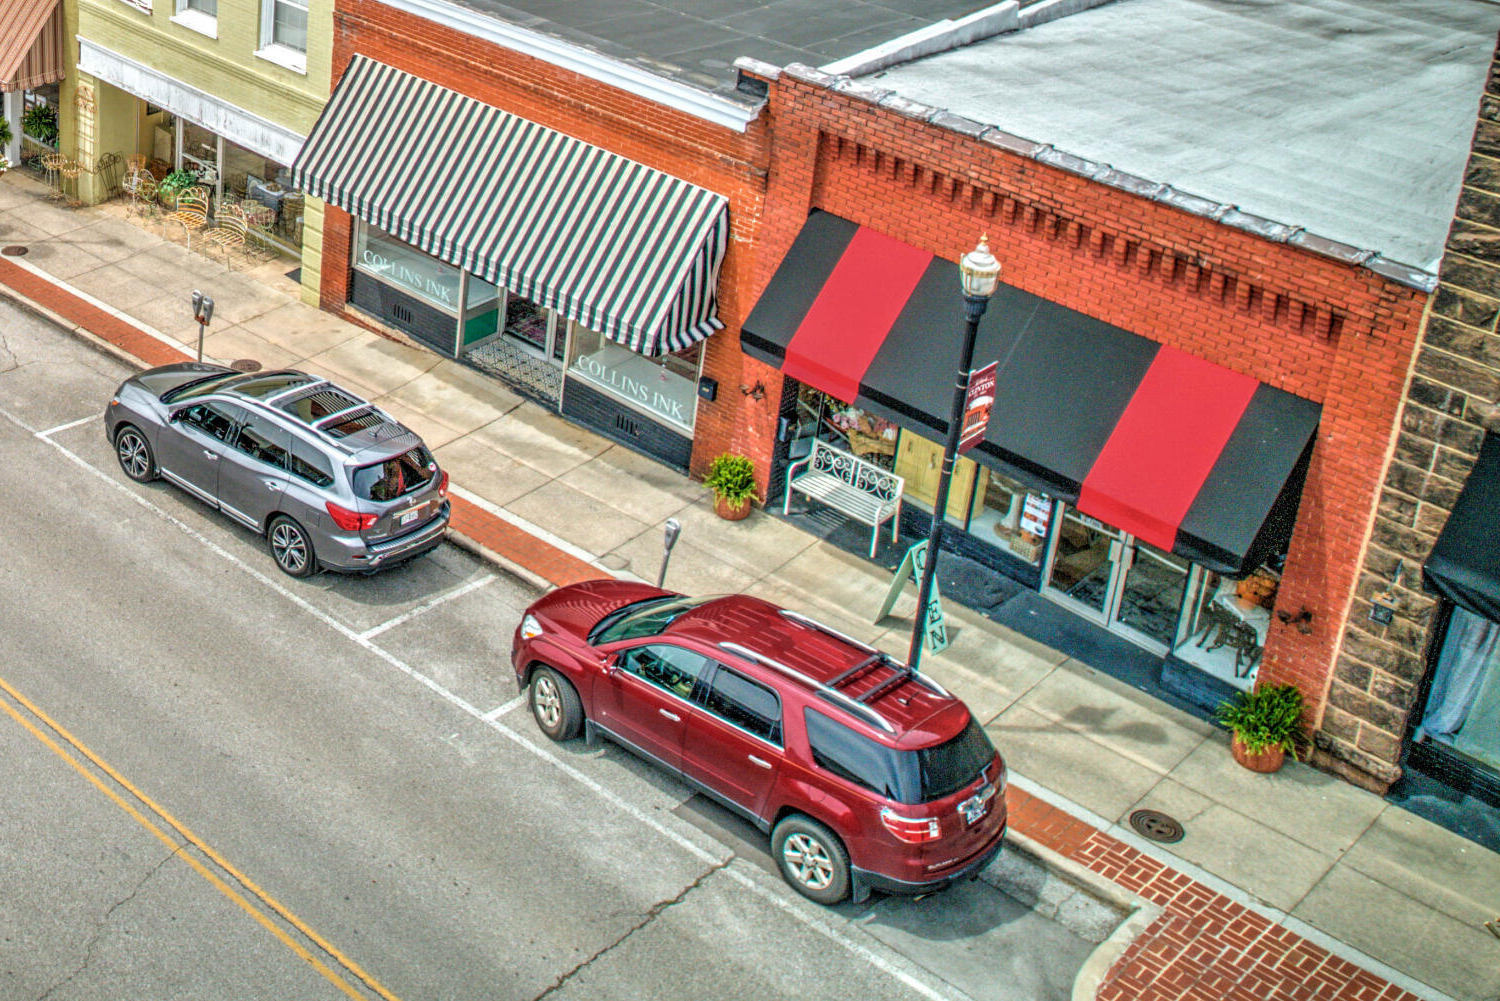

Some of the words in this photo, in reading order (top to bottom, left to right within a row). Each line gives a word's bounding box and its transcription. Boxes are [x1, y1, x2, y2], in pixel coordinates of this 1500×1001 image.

[363, 249, 422, 287] COLLINS
[426, 279, 451, 302] INK
[578, 354, 649, 401] COLLINS
[653, 391, 684, 419] INK
[968, 380, 995, 398] CLINTON
[916, 547, 946, 650] OEN
